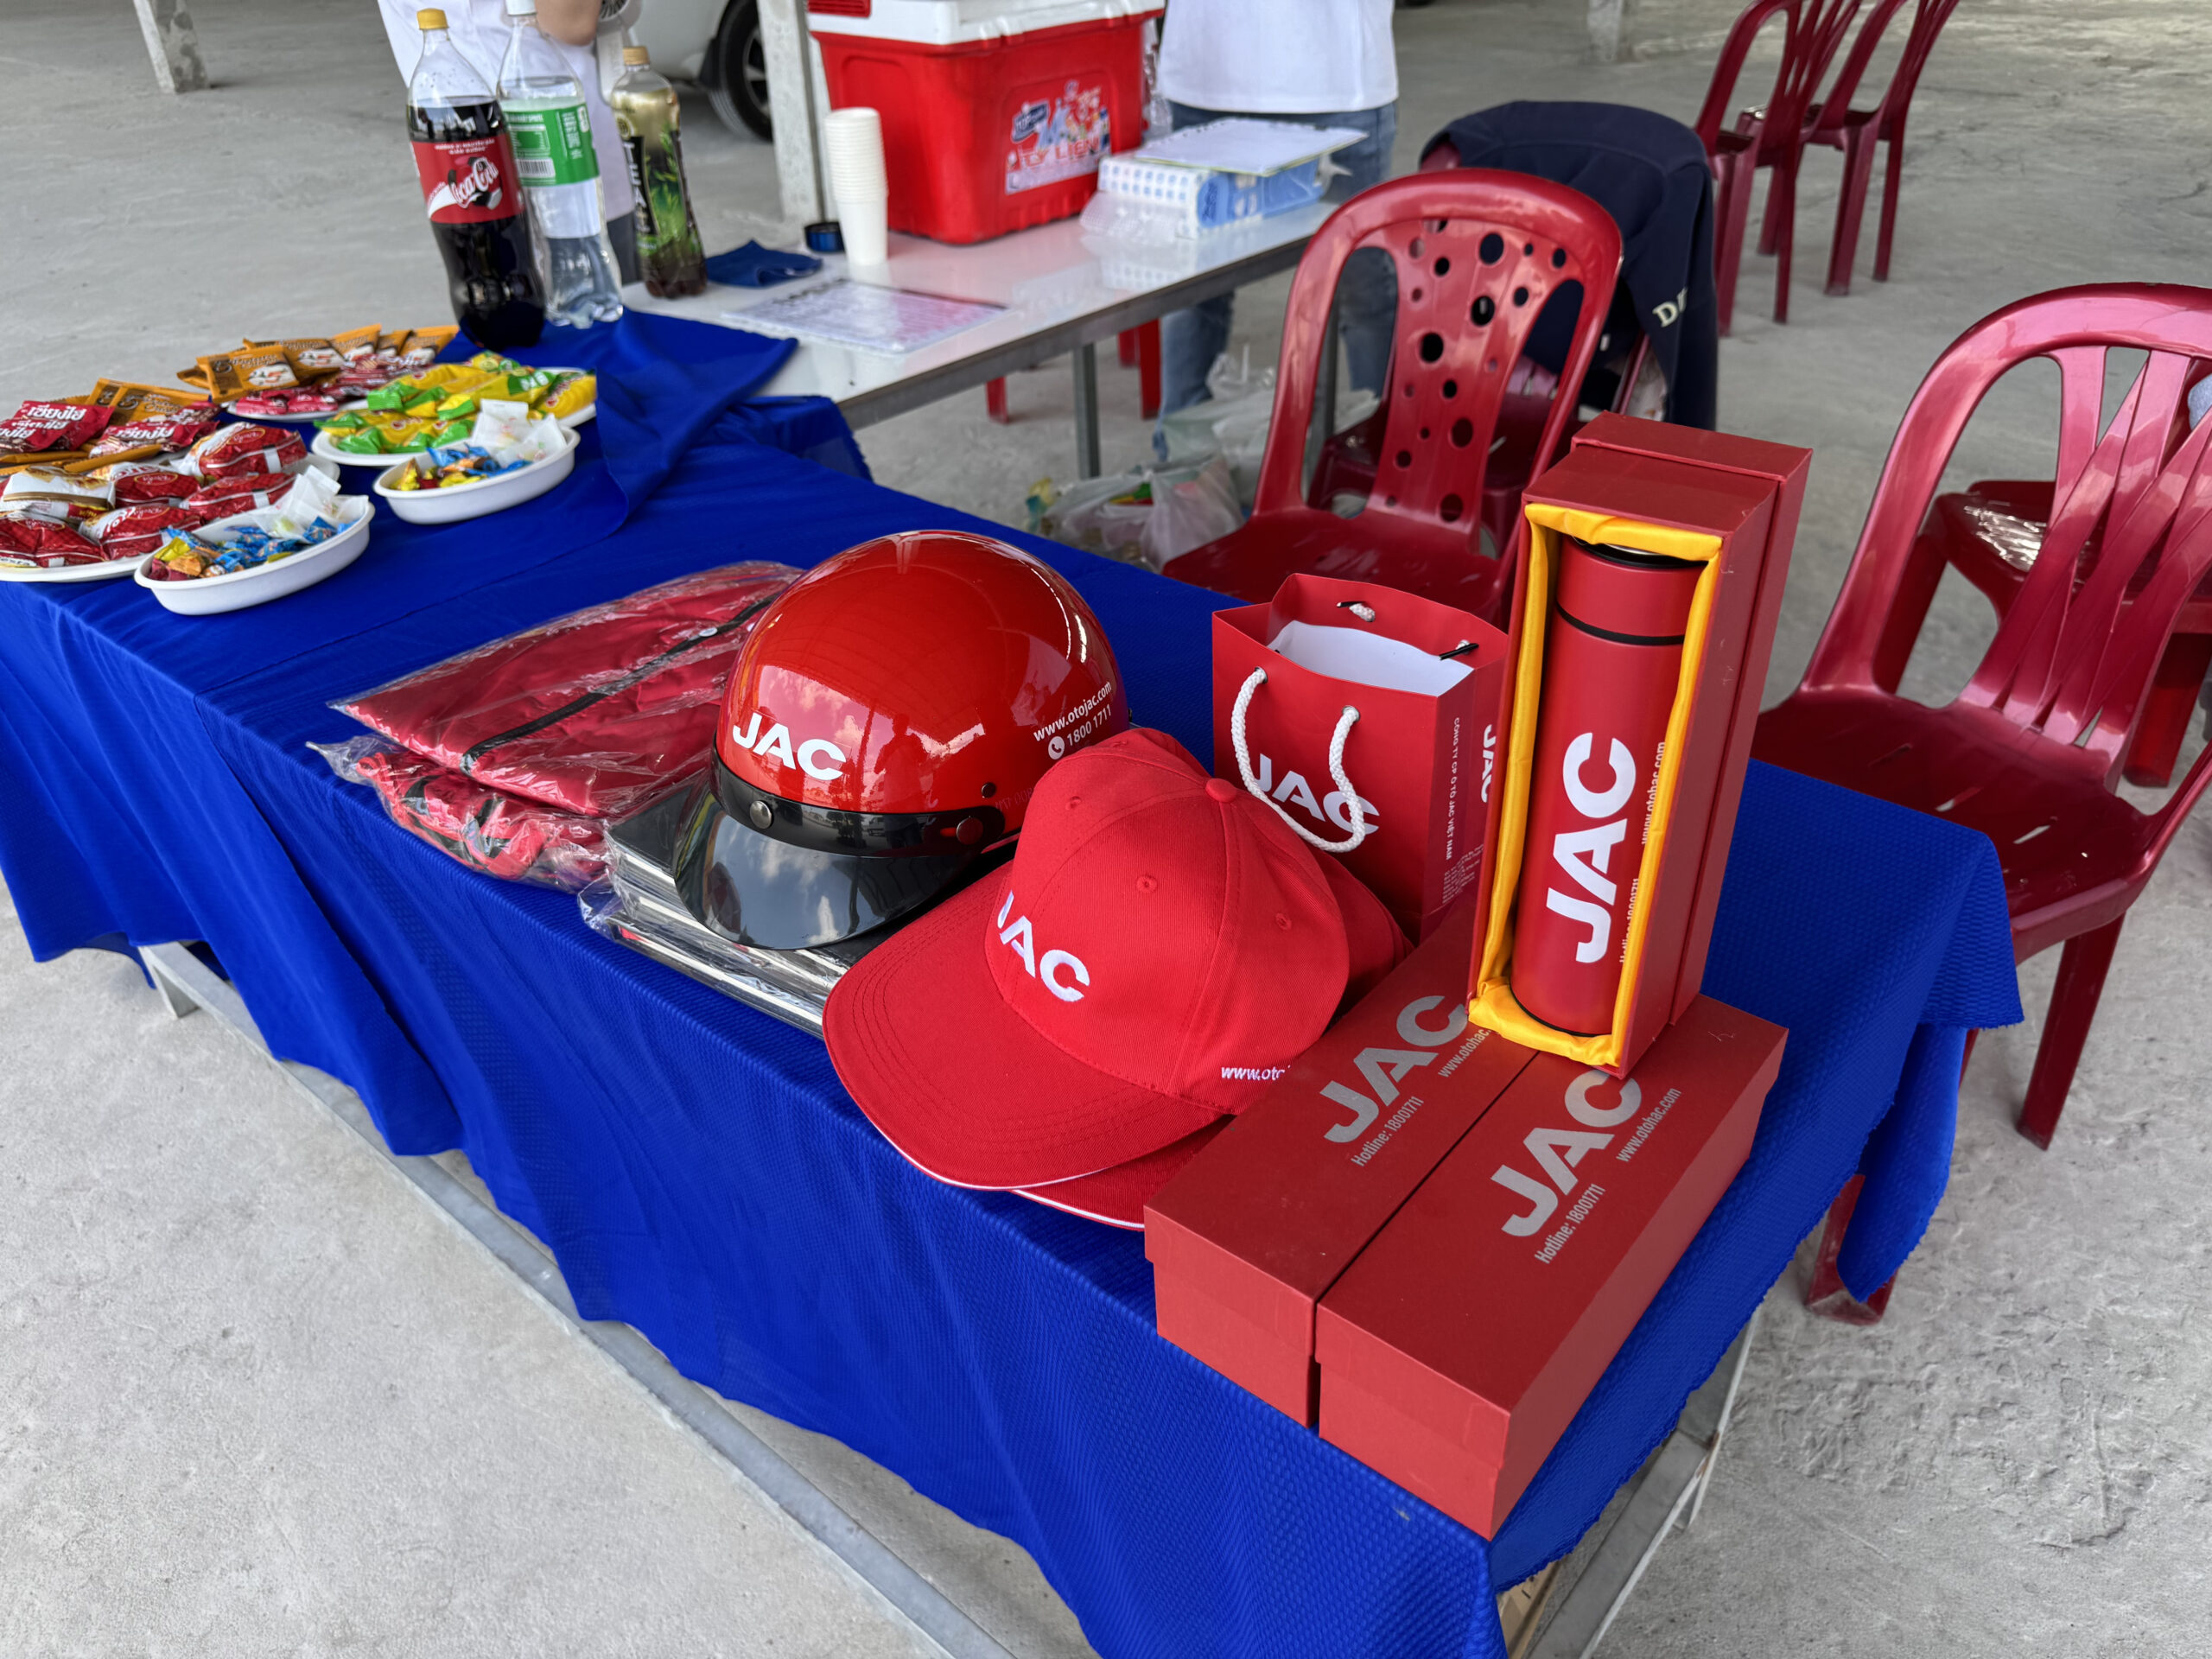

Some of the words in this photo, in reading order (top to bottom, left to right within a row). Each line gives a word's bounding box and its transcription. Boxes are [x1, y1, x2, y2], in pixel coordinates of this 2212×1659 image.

[733, 712, 847, 781] JAC
[1033, 681, 1112, 742] www.otojac.com
[1067, 721, 1092, 747] 1800
[1093, 703, 1112, 728] 1711
[1253, 753, 1380, 835] JAC
[1547, 732, 1637, 963] JAC
[1319, 995, 1468, 1143] JAC
[1351, 1130, 1393, 1166] Hotline:
[1384, 1096, 1424, 1132] 18001711
[1491, 1069, 1642, 1237] JAC
[1616, 1088, 1681, 1162] www.otohac.com
[1534, 1223, 1576, 1264] Hotline:
[1565, 1184, 1605, 1224] 18001711
